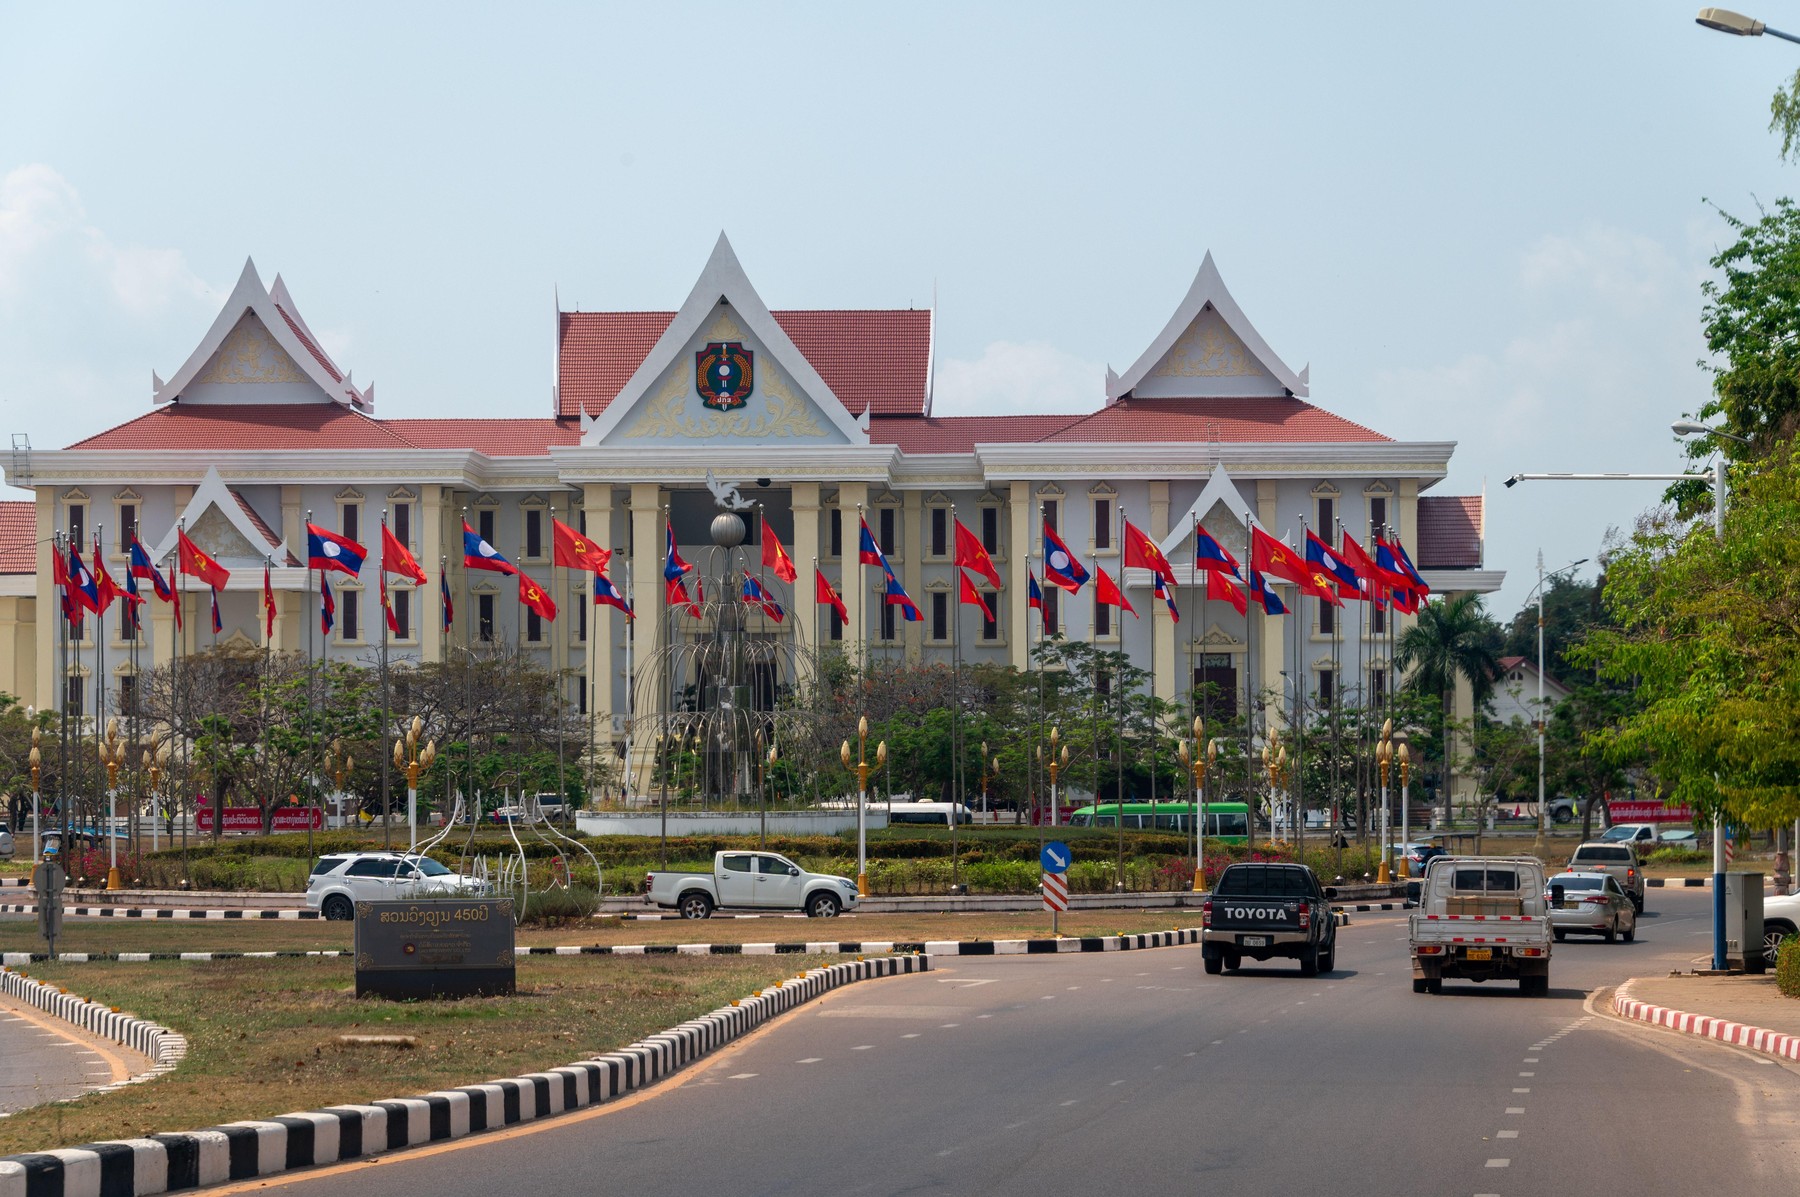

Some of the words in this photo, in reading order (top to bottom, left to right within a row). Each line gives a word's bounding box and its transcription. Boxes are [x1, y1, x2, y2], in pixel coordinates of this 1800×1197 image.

[380, 906, 450, 926] ສວນວົງວຽນ
[1224, 907, 1287, 920] TOYOTA
